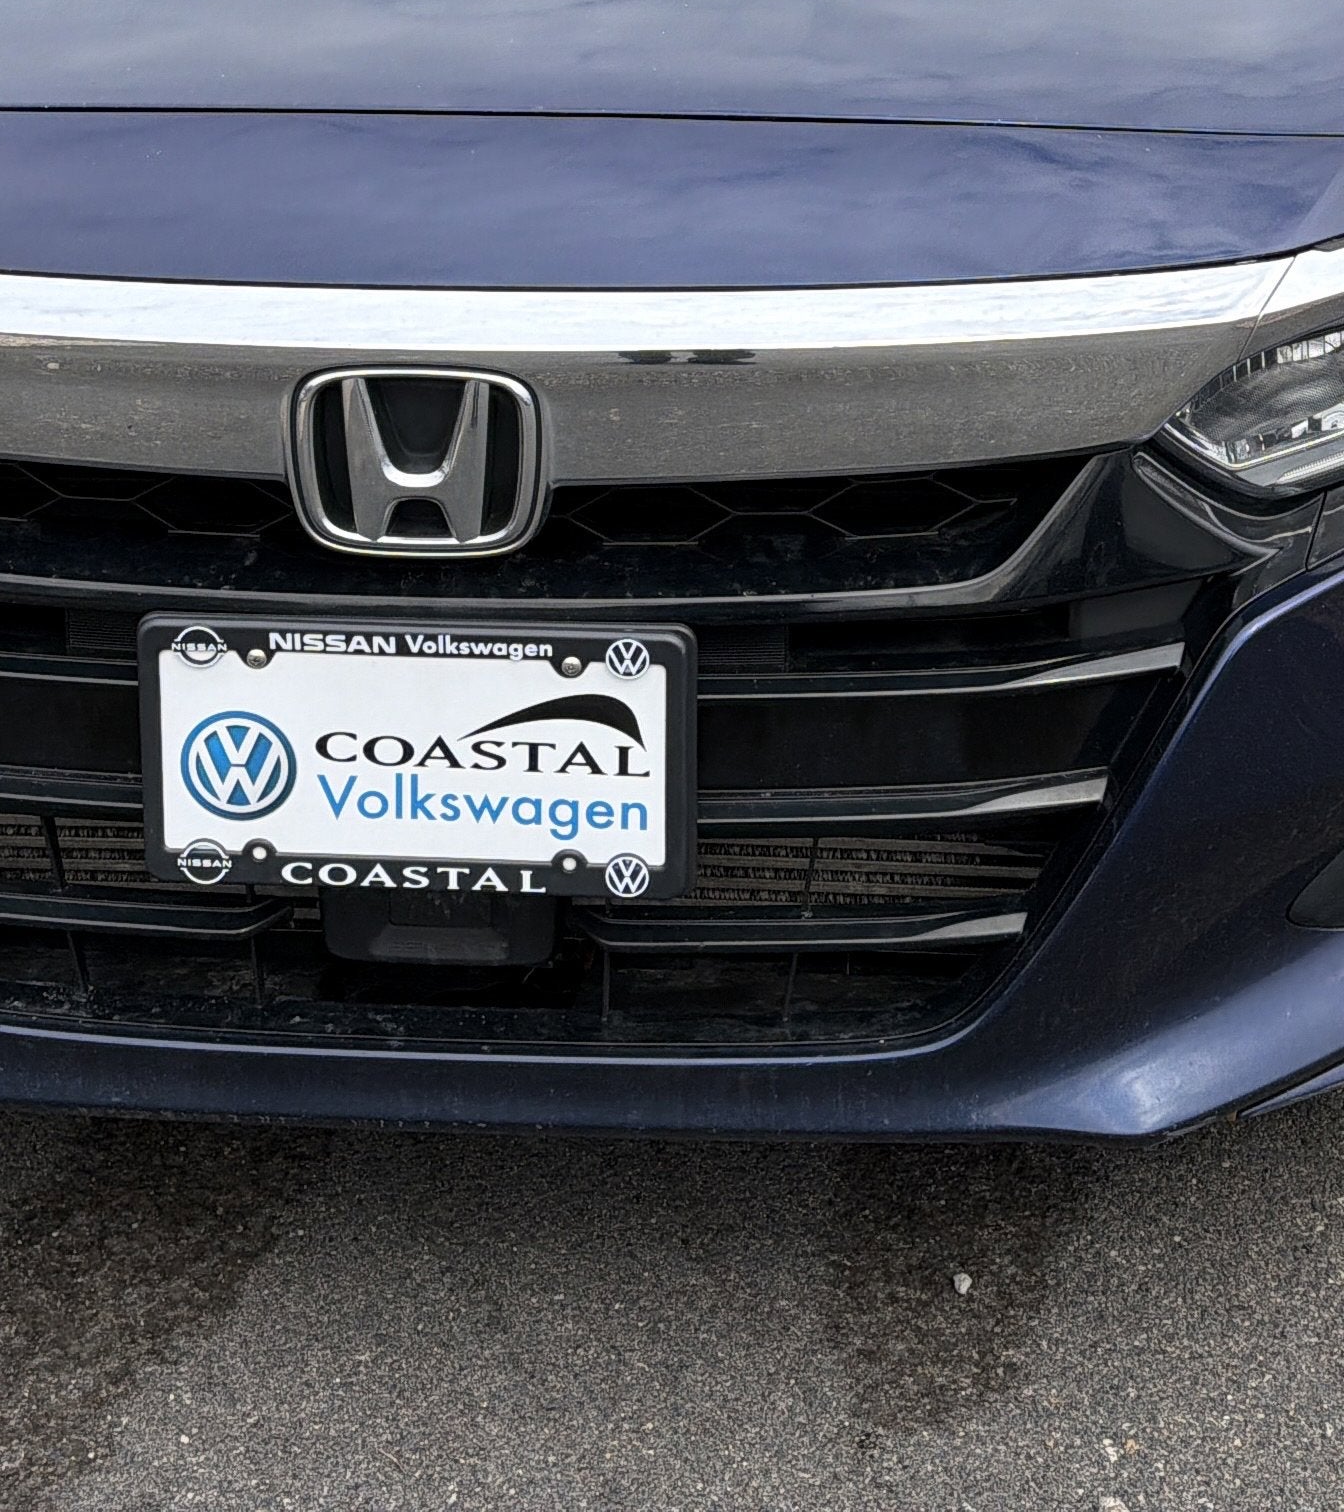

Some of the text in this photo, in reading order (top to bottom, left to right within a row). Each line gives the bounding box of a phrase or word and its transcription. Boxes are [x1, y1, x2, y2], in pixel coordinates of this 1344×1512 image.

[171, 642, 227, 653] NISSAN
[269, 632, 553, 661] NISSAN Volkswagen
[315, 732, 651, 777] COASTAL
[317, 773, 649, 841] Volkswagen
[177, 858, 232, 868] NISSAN
[281, 862, 547, 894] COASTAL
